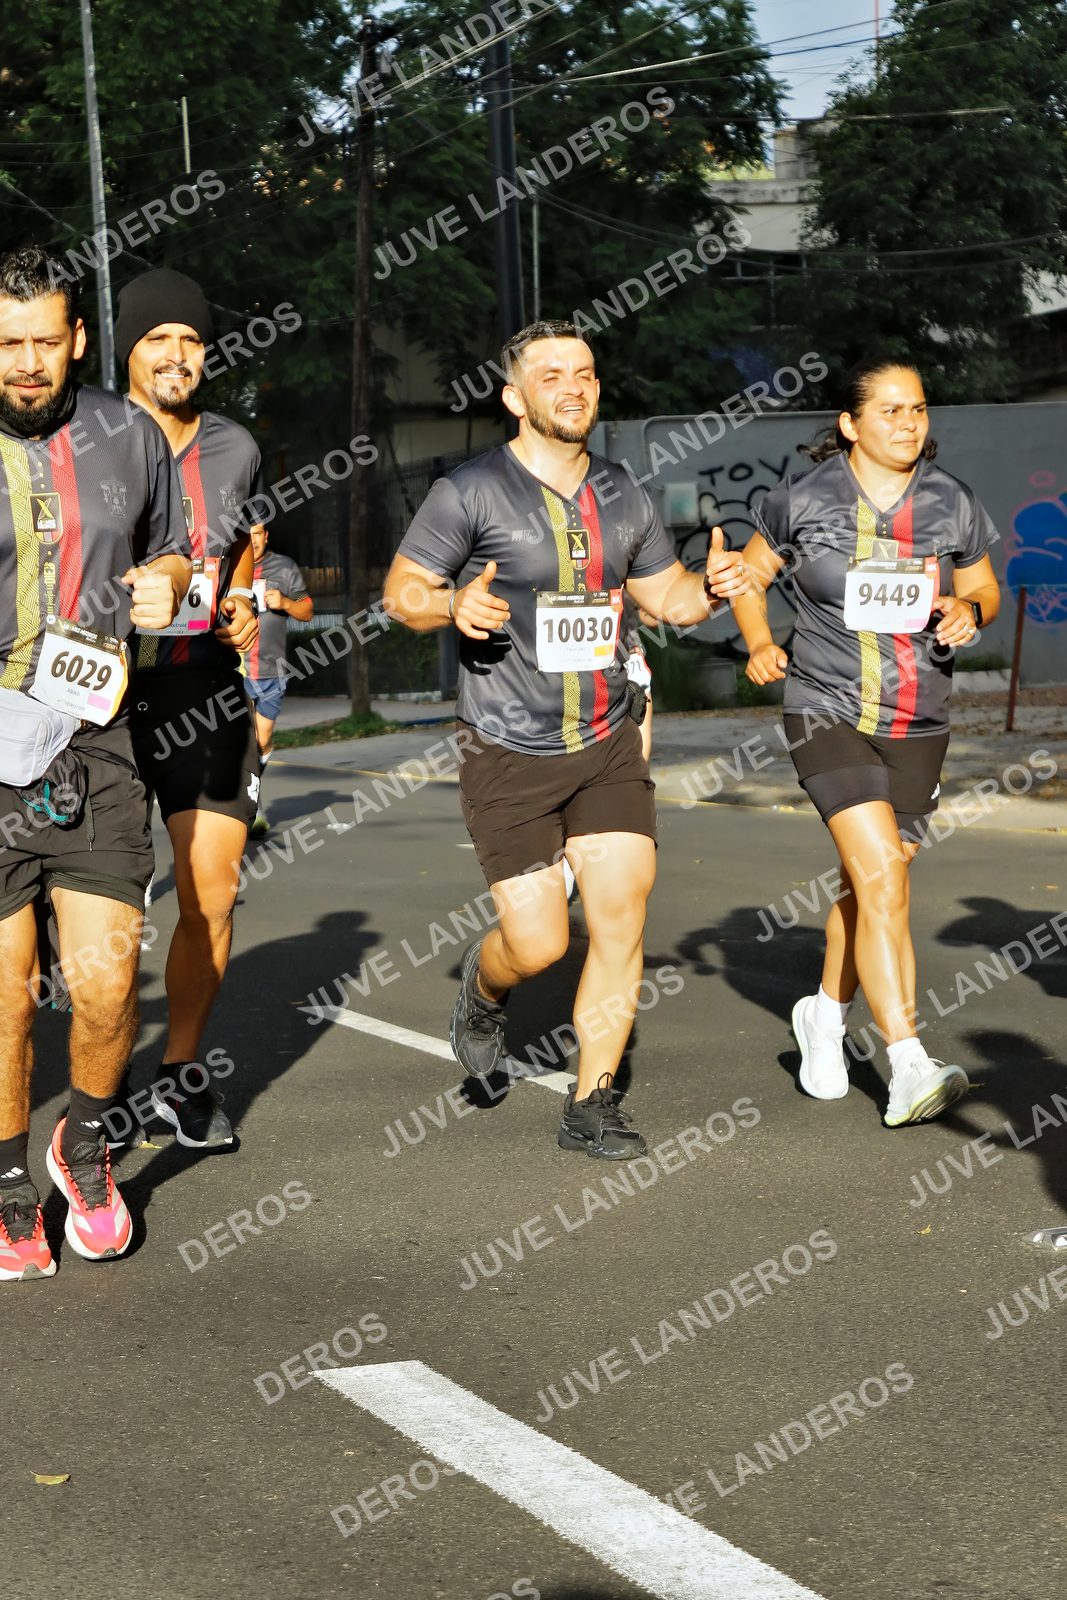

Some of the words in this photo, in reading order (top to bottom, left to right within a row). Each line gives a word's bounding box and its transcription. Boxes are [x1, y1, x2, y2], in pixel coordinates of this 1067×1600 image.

[698, 455, 790, 487] TOY
[858, 583, 920, 606] 9449
[543, 616, 614, 643] 10030
[50, 650, 112, 691] 6029
